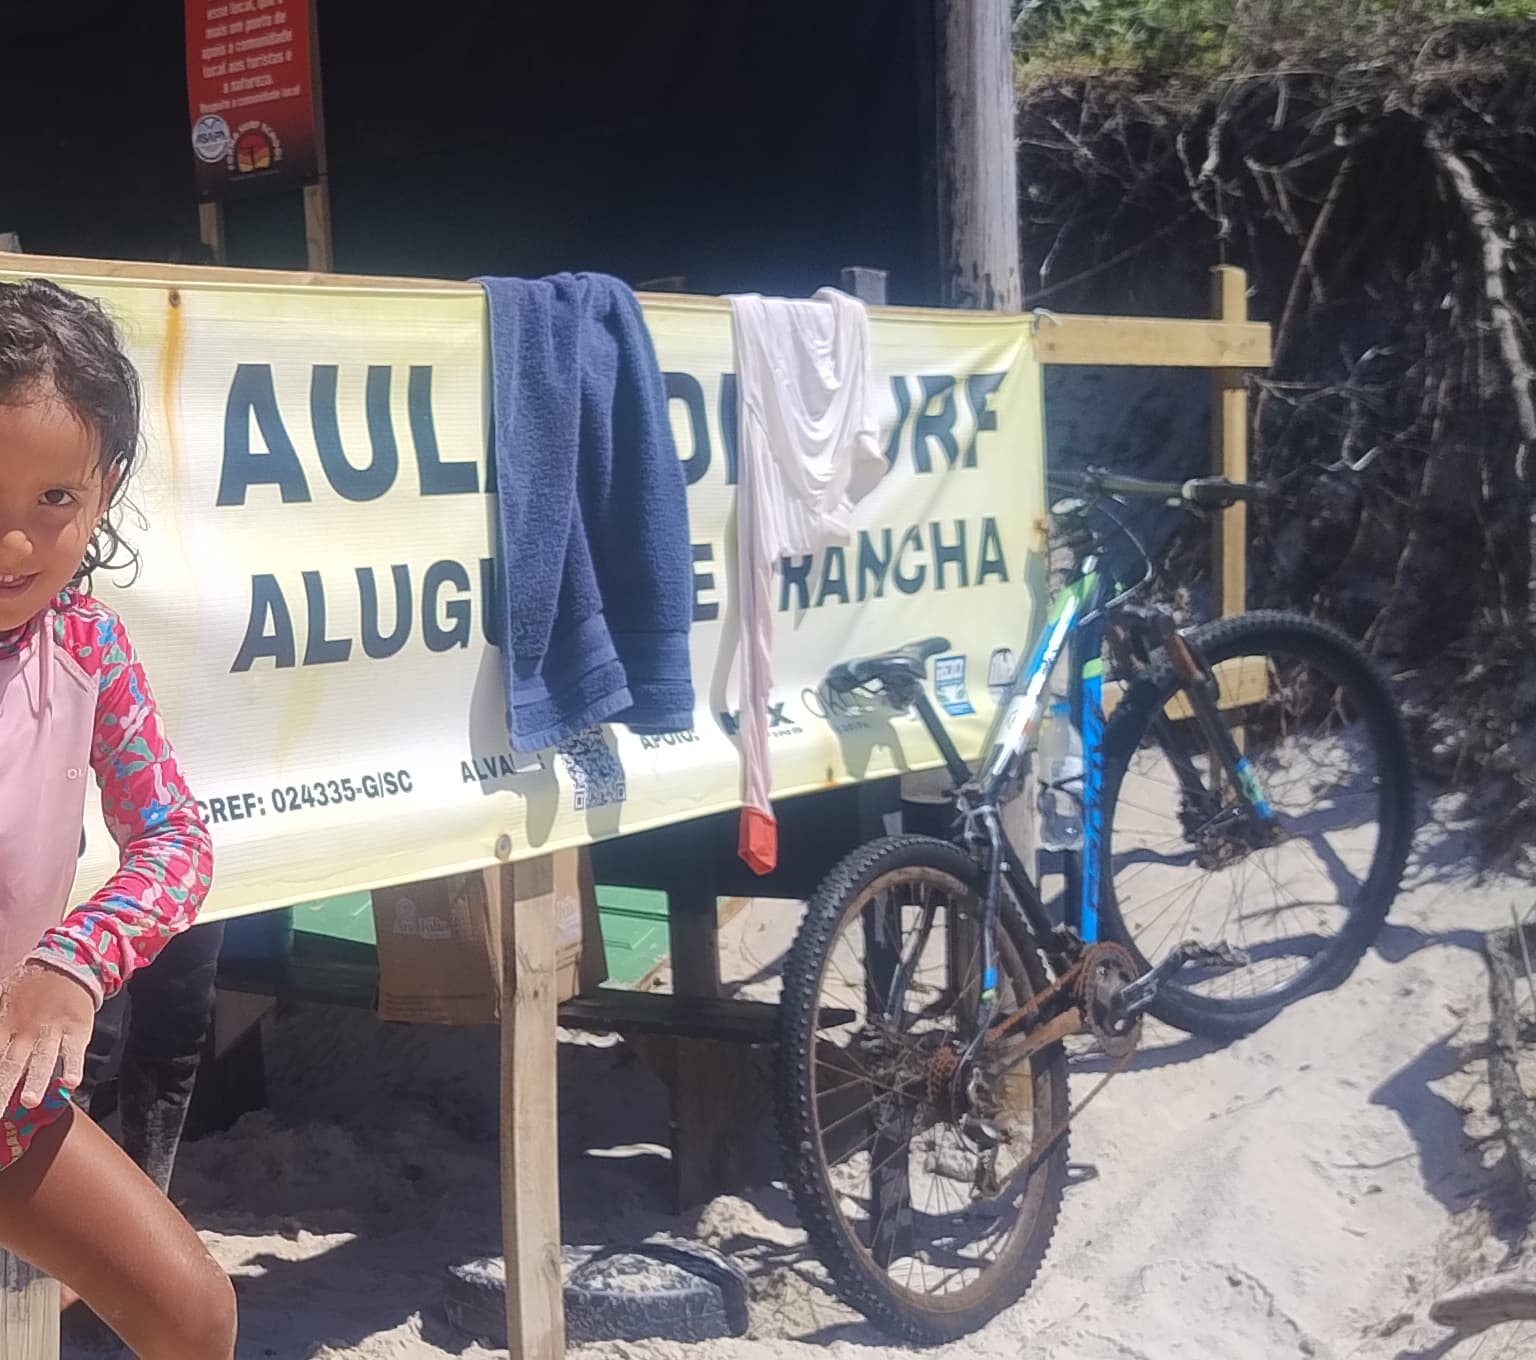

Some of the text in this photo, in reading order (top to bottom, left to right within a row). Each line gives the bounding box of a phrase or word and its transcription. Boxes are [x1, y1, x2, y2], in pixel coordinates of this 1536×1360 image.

[216, 363, 498, 507] AUL
[229, 557, 508, 674] ALUG
[778, 516, 1010, 613] RANCHA
[198, 793, 267, 828] CREF:
[270, 769, 414, 815] 024335-G/SC
